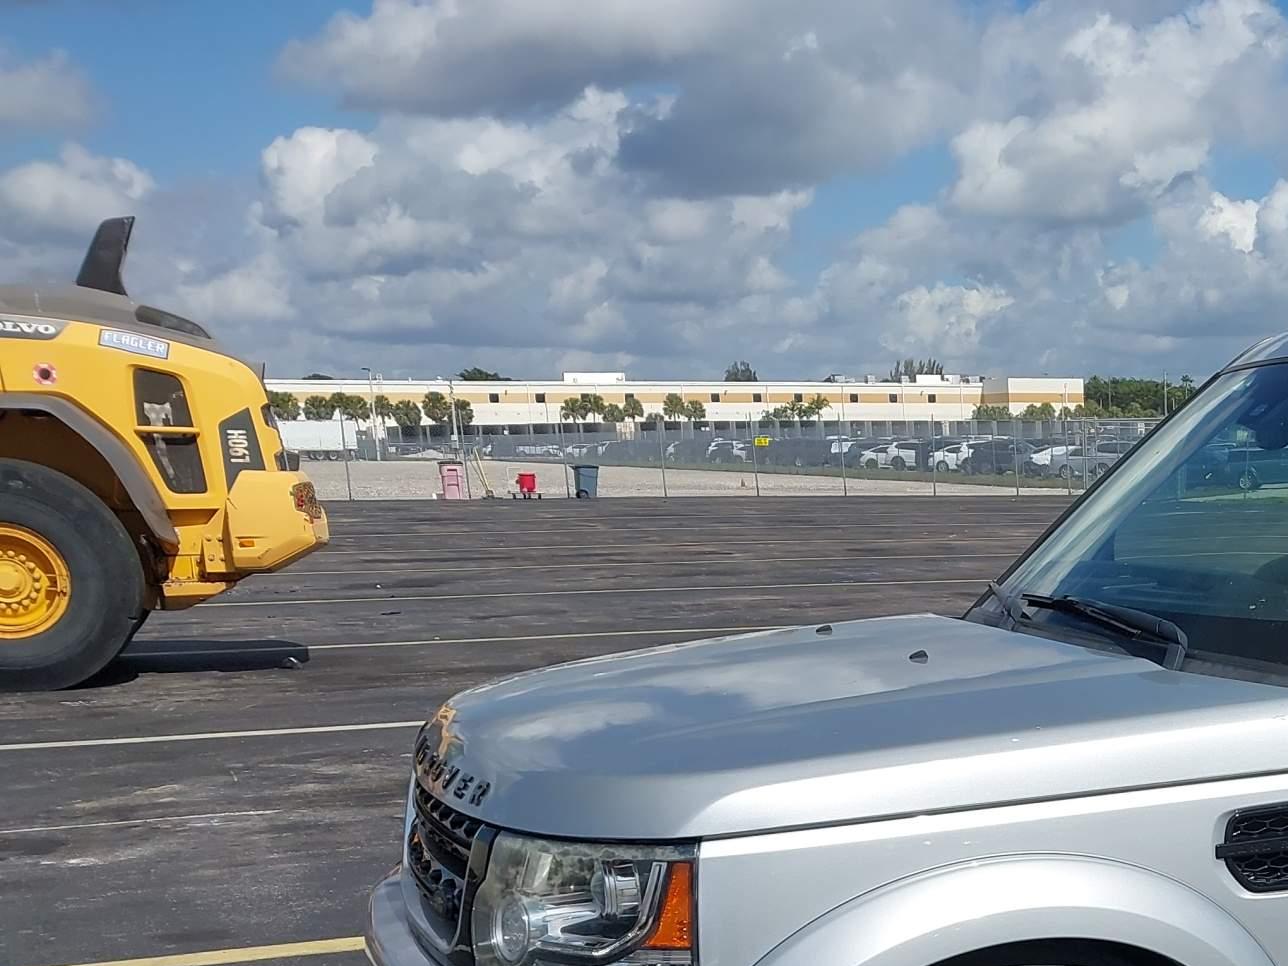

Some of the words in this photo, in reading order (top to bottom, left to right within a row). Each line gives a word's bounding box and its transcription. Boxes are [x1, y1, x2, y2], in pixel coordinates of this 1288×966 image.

[0, 320, 56, 335] LVO
[103, 329, 166, 354] FLAGLER
[226, 429, 250, 463] L90H
